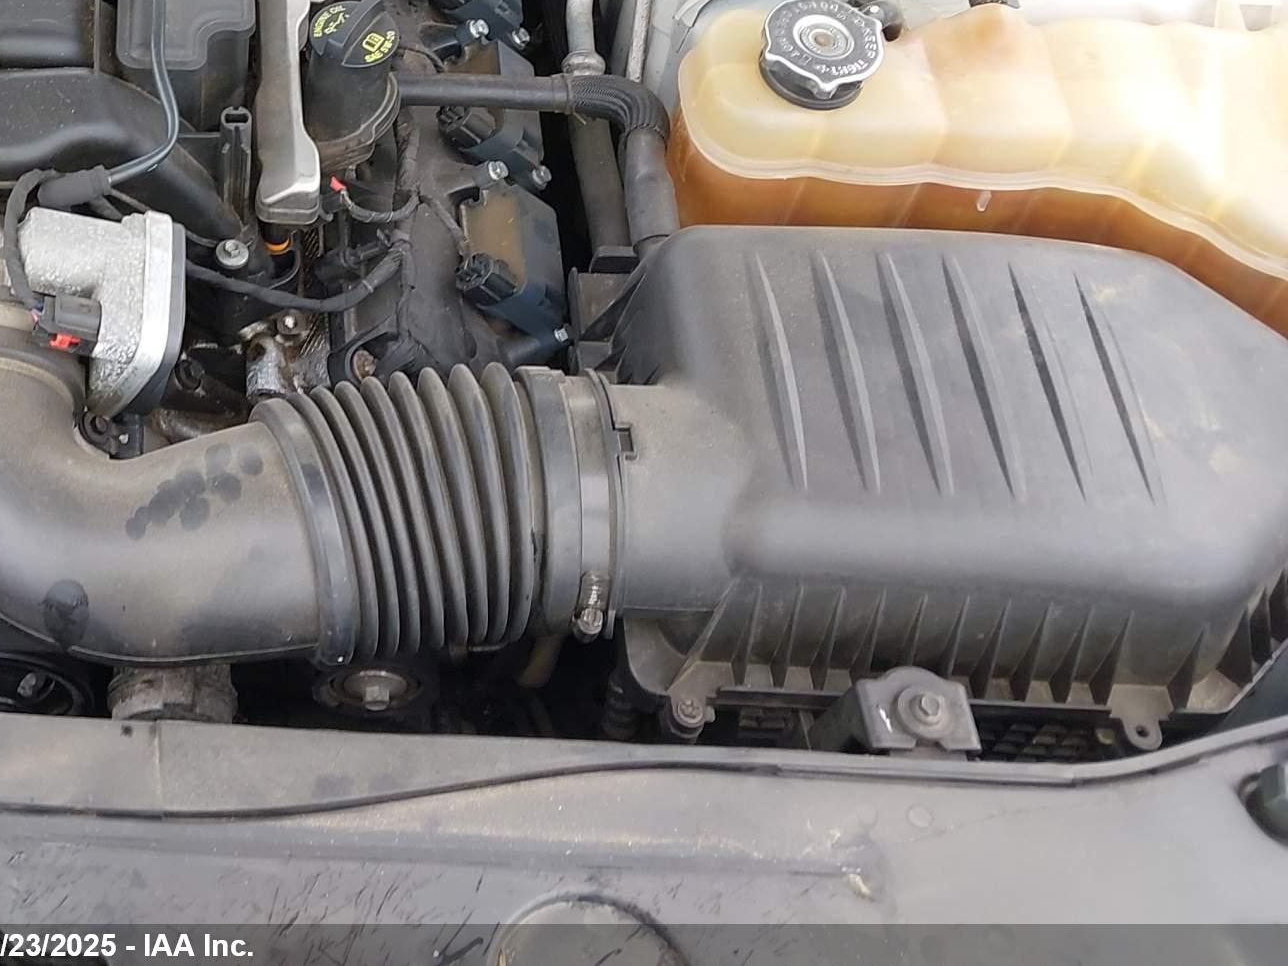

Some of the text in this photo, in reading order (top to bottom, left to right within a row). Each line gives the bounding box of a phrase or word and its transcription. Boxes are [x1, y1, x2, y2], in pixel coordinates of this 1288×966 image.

[313, 4, 347, 38] ENGINE OIL
[364, 49, 384, 63] SAE
[831, 27, 877, 76] KEEP TIGHT
